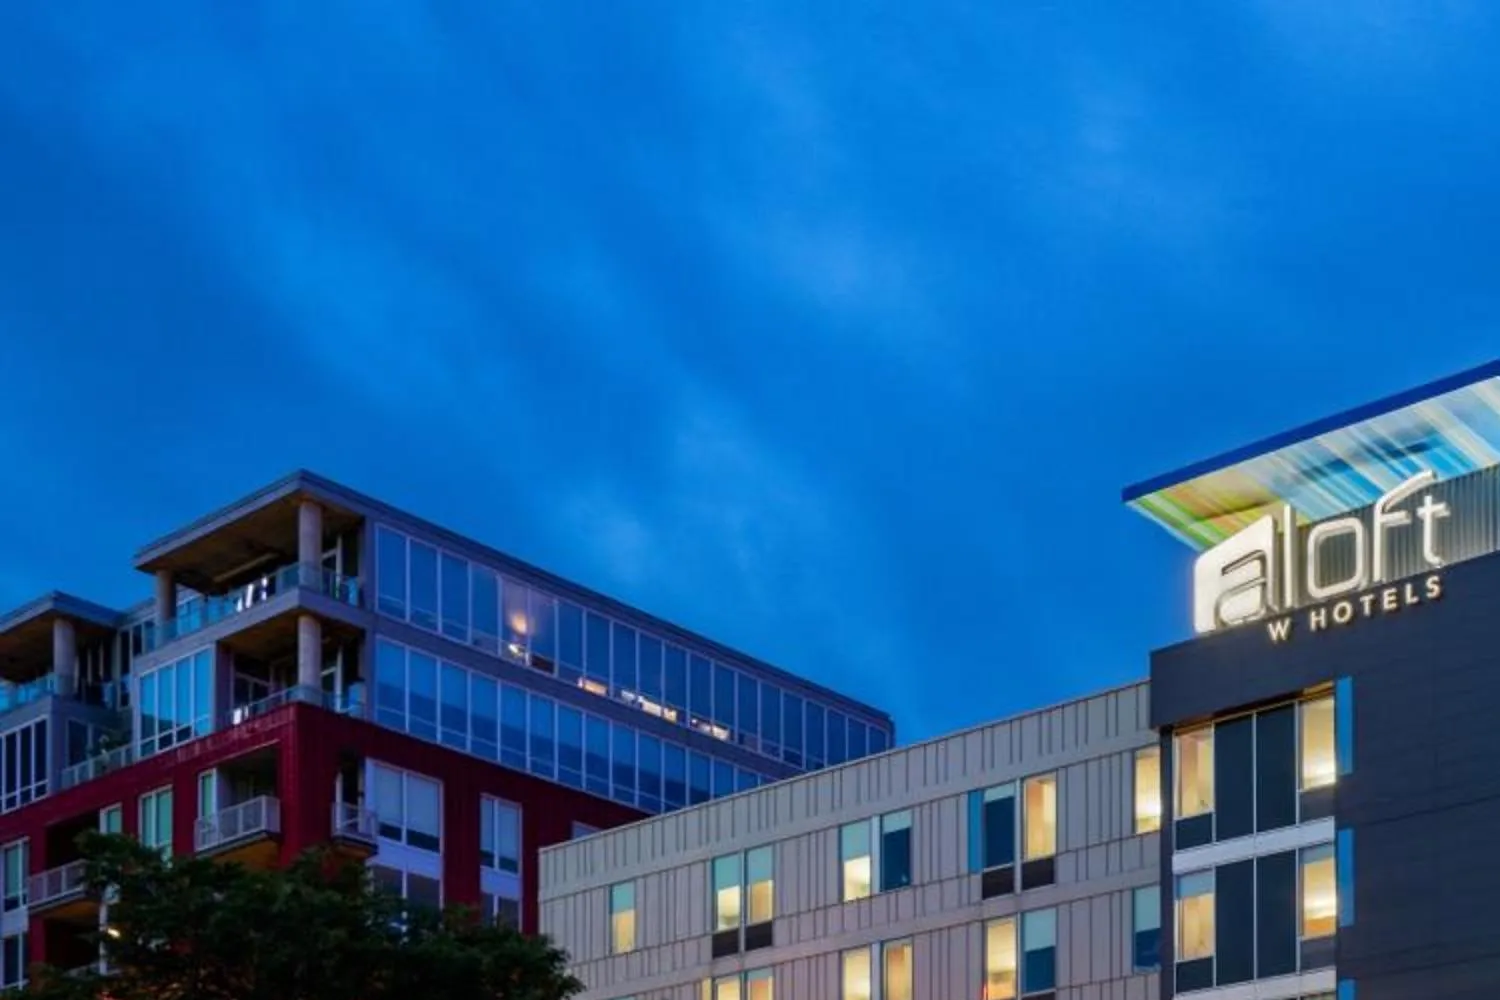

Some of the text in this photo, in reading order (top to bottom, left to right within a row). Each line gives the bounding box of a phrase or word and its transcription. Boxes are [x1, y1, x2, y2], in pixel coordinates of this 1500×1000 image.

[1194, 469, 1451, 633] aloft
[1268, 575, 1442, 642] W HOTELS
